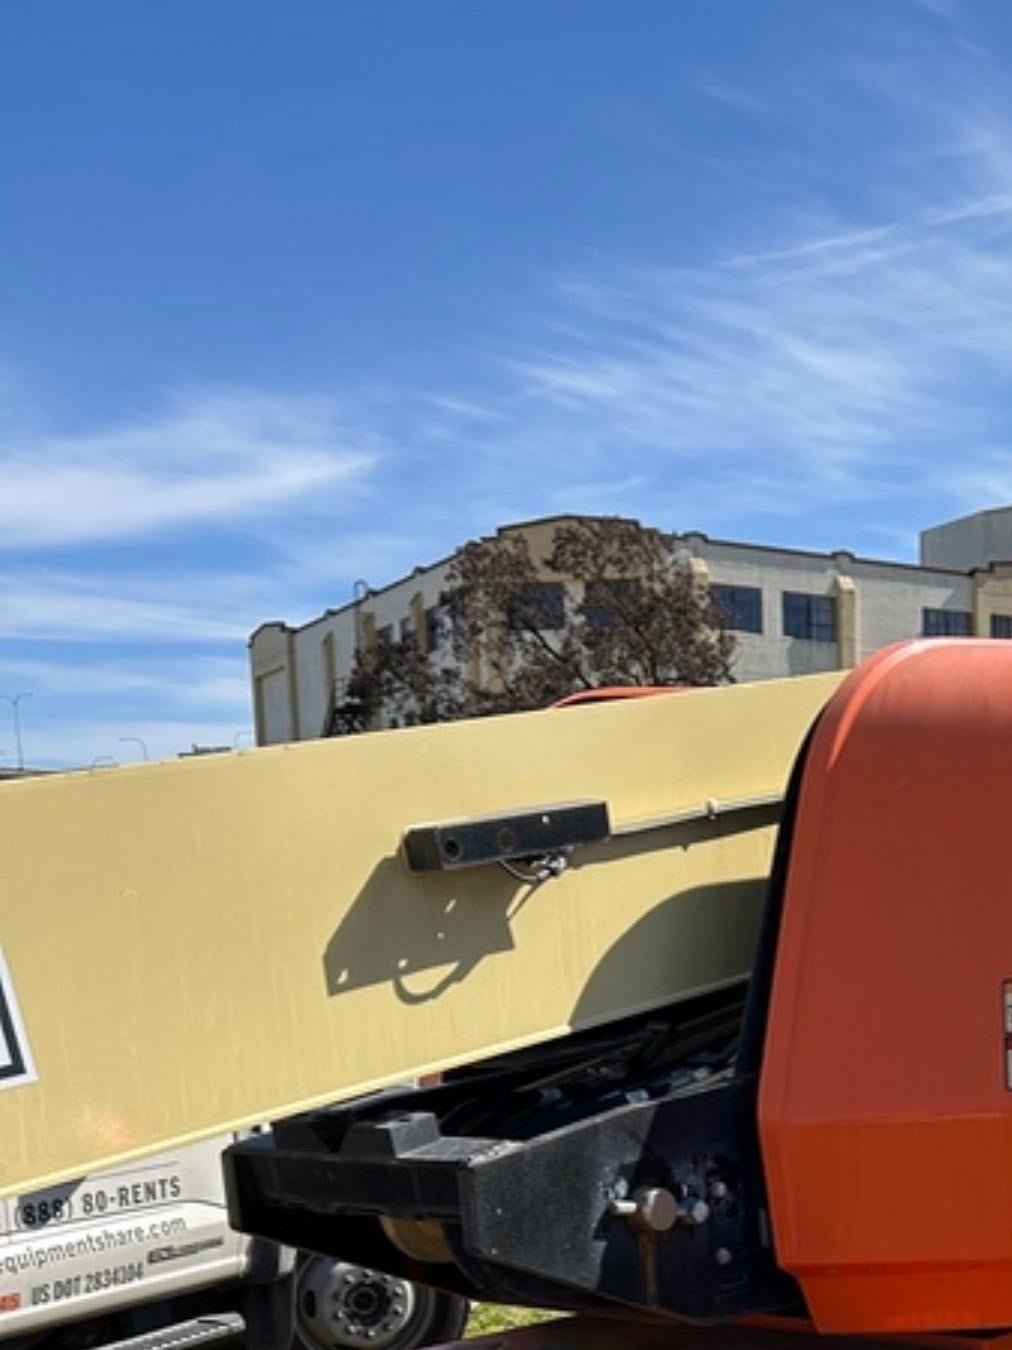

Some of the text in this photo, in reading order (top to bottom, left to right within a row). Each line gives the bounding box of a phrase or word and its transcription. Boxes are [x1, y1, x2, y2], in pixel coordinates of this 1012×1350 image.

[82, 1176, 181, 1216] 80-RENTS
[0, 1216, 187, 1275] quipmentshare.com
[31, 1284, 49, 1306] US
[53, 1274, 81, 1300] DOT
